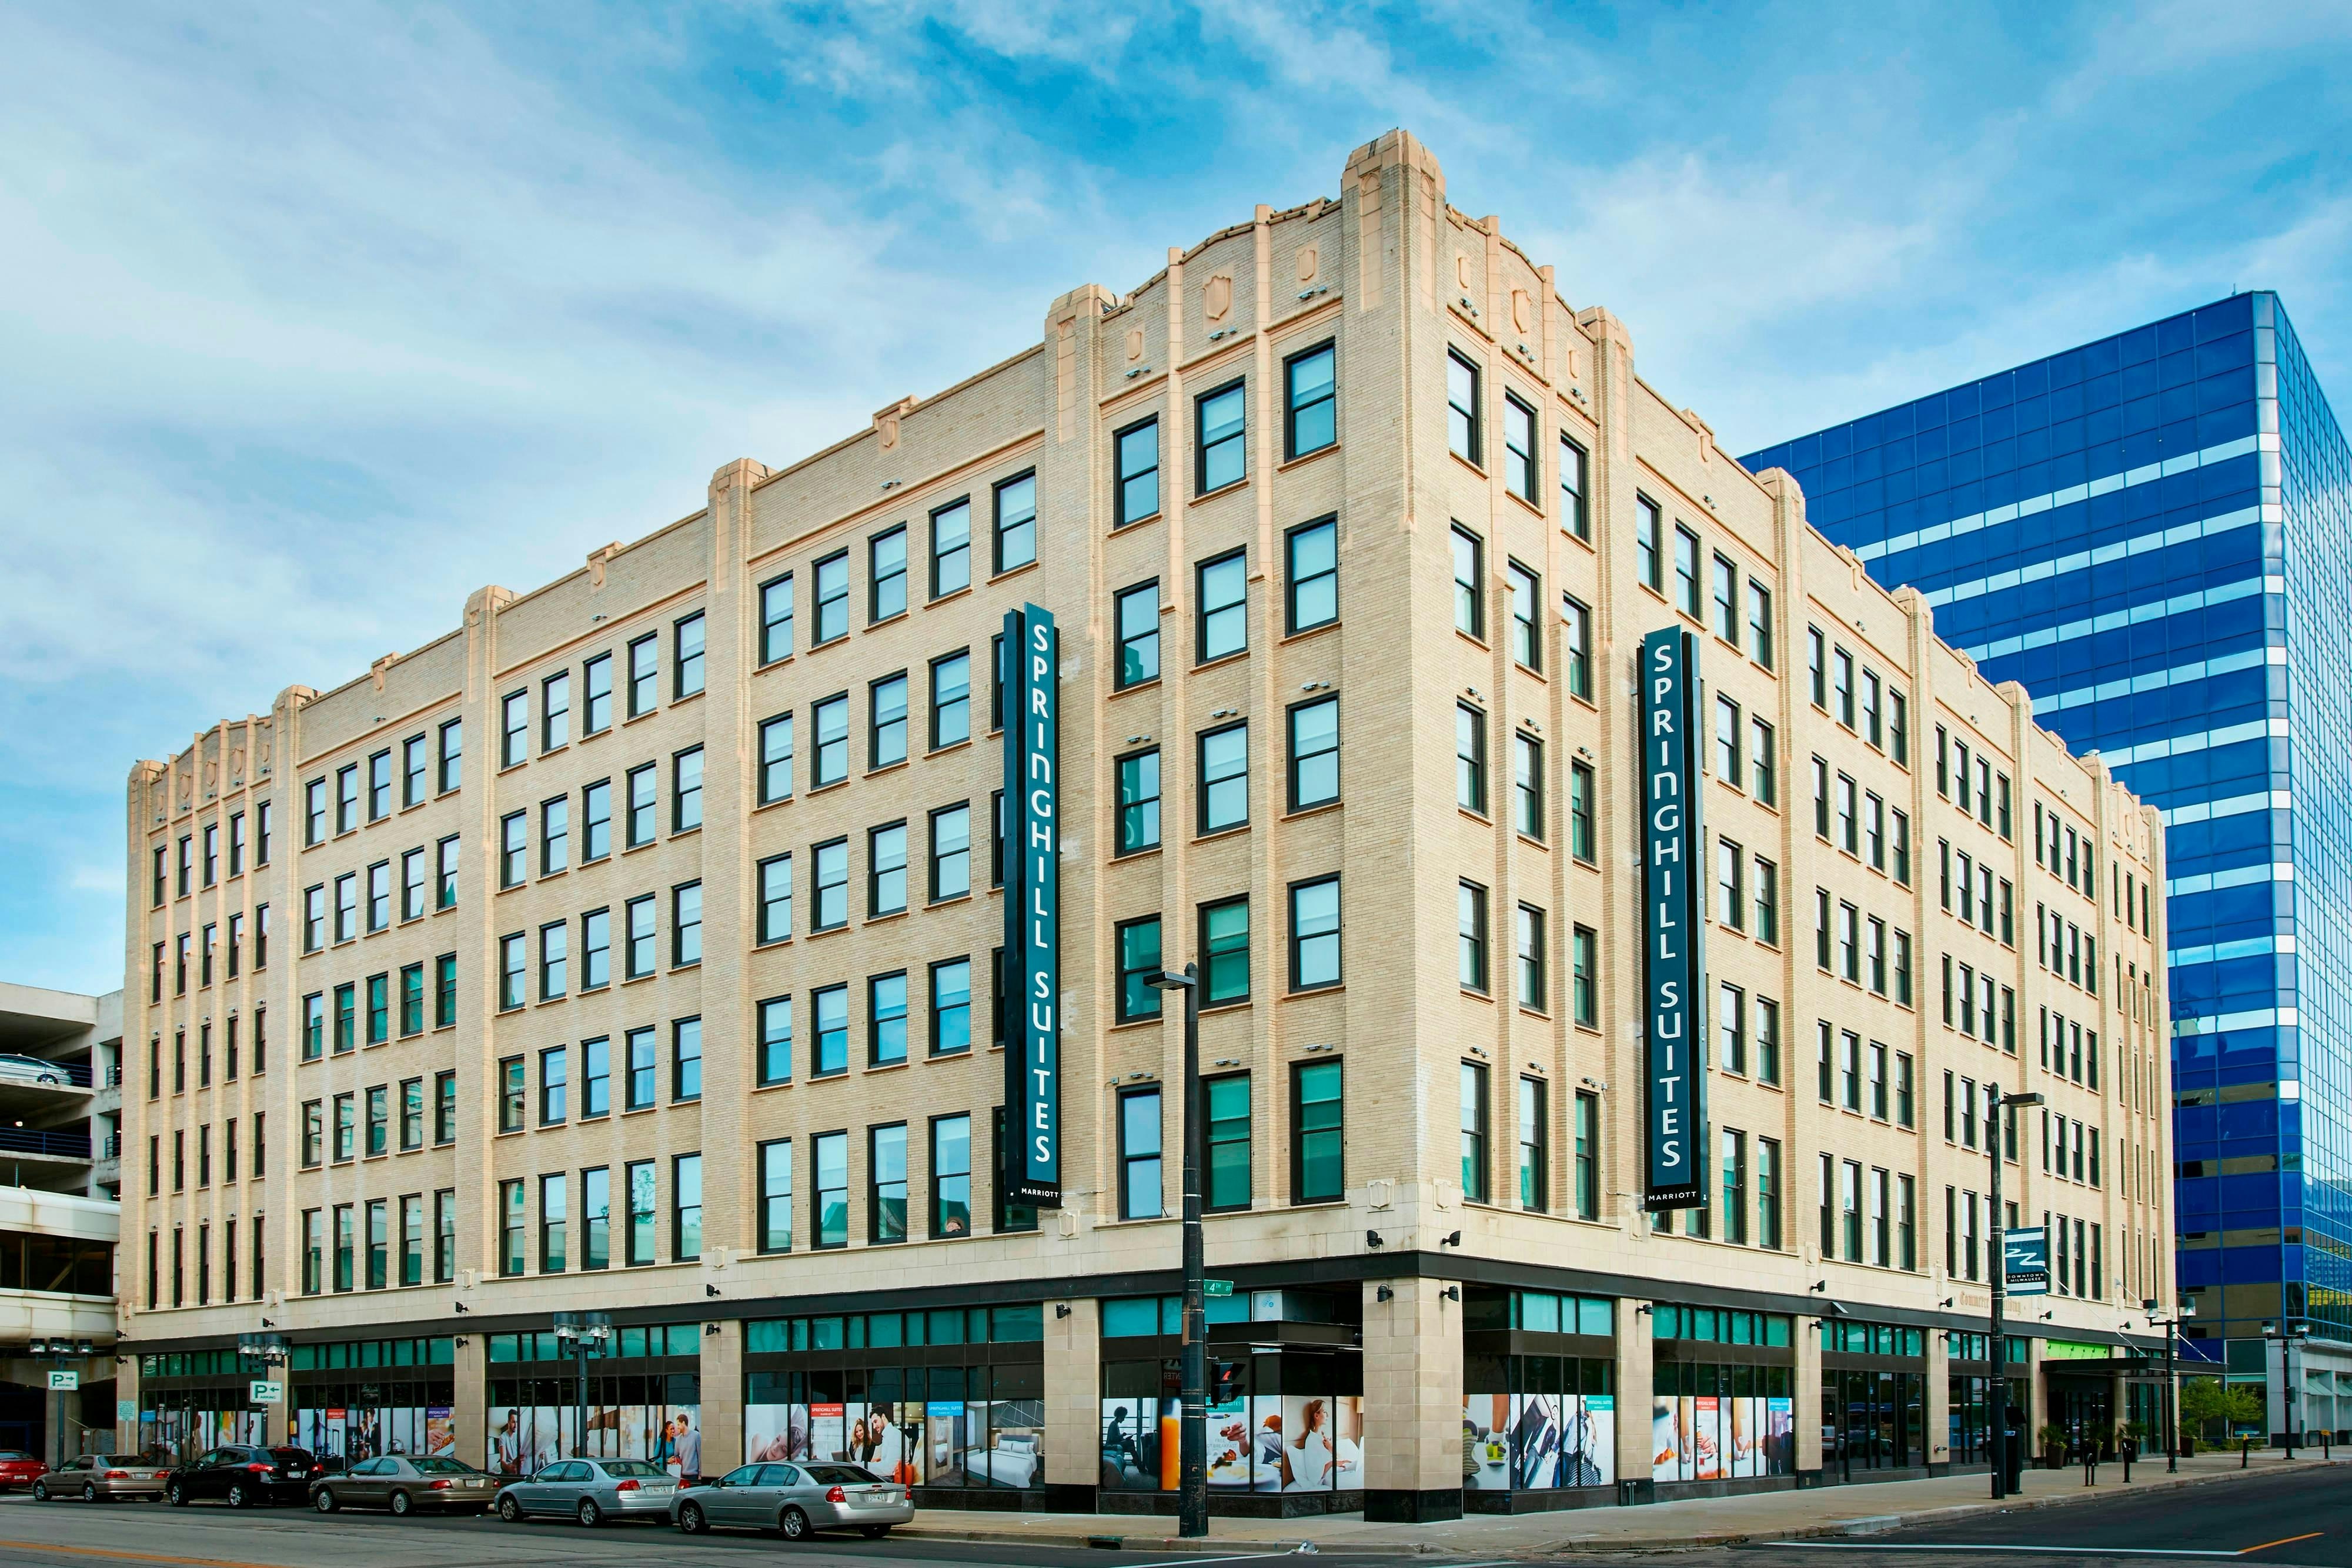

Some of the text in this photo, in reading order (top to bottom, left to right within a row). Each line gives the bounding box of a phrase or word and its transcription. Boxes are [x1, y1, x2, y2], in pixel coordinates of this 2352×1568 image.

[1031, 624, 1051, 1162] SPRINGHILL SUITES
[1653, 645, 1681, 1167] SPRINGHILL SUITES
[1021, 1188, 1059, 1198] MARRIOTT
[1648, 1191, 1696, 1201] MARRIOTT
